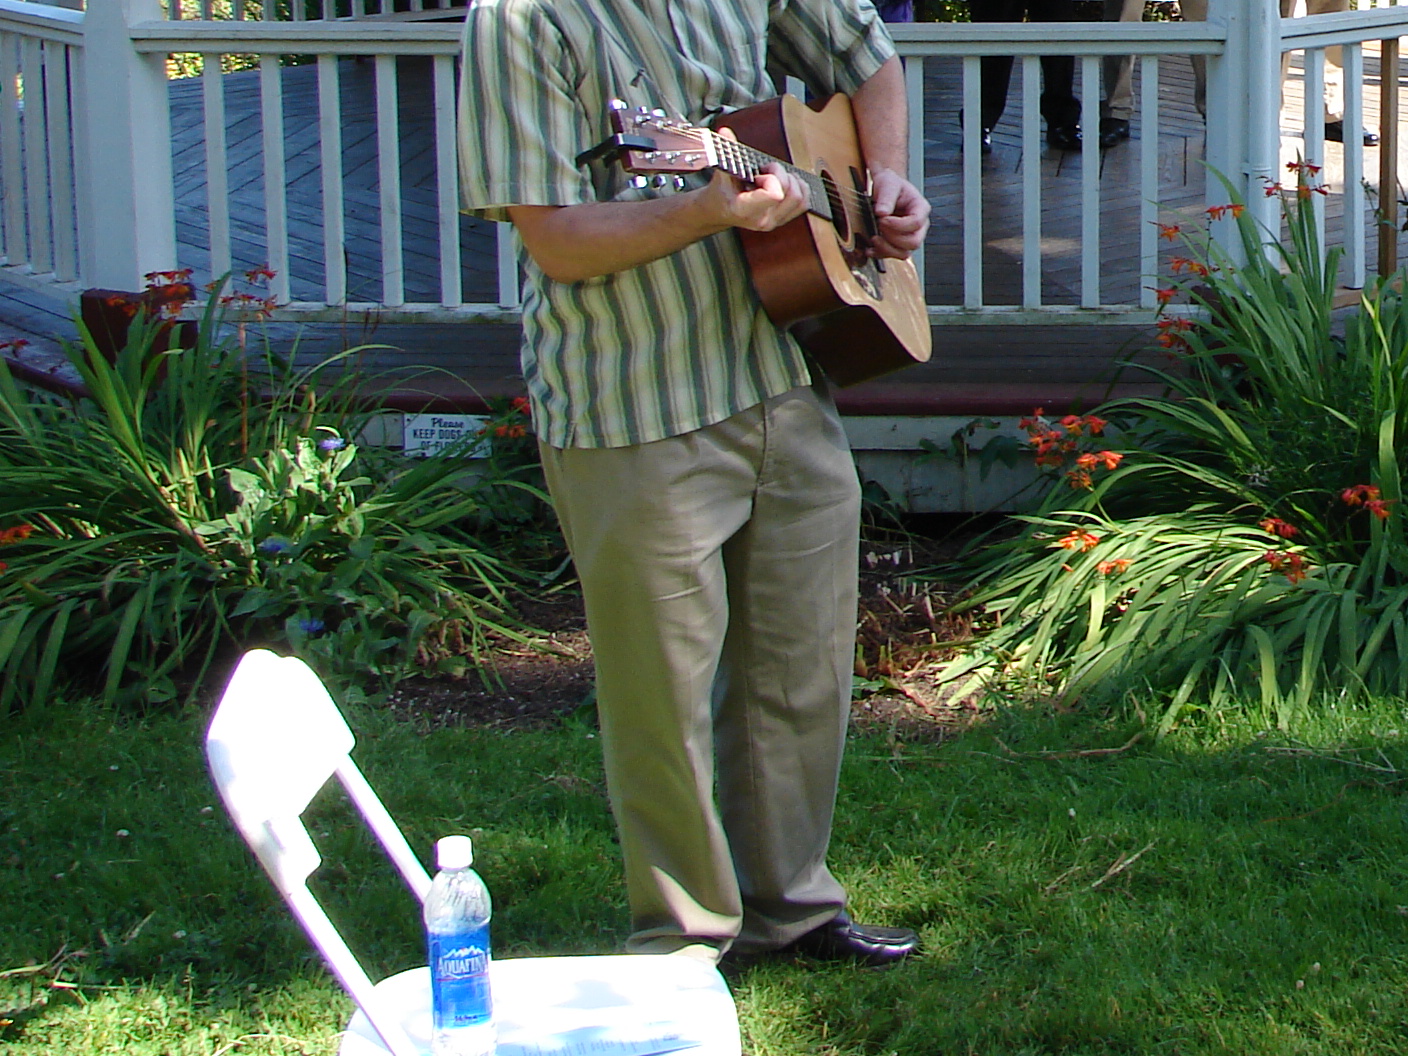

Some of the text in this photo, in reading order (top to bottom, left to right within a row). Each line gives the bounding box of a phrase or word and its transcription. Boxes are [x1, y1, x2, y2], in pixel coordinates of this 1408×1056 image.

[431, 417, 464, 428] Please
[413, 429, 436, 439] KEEP
[438, 429, 462, 440] DOGS
